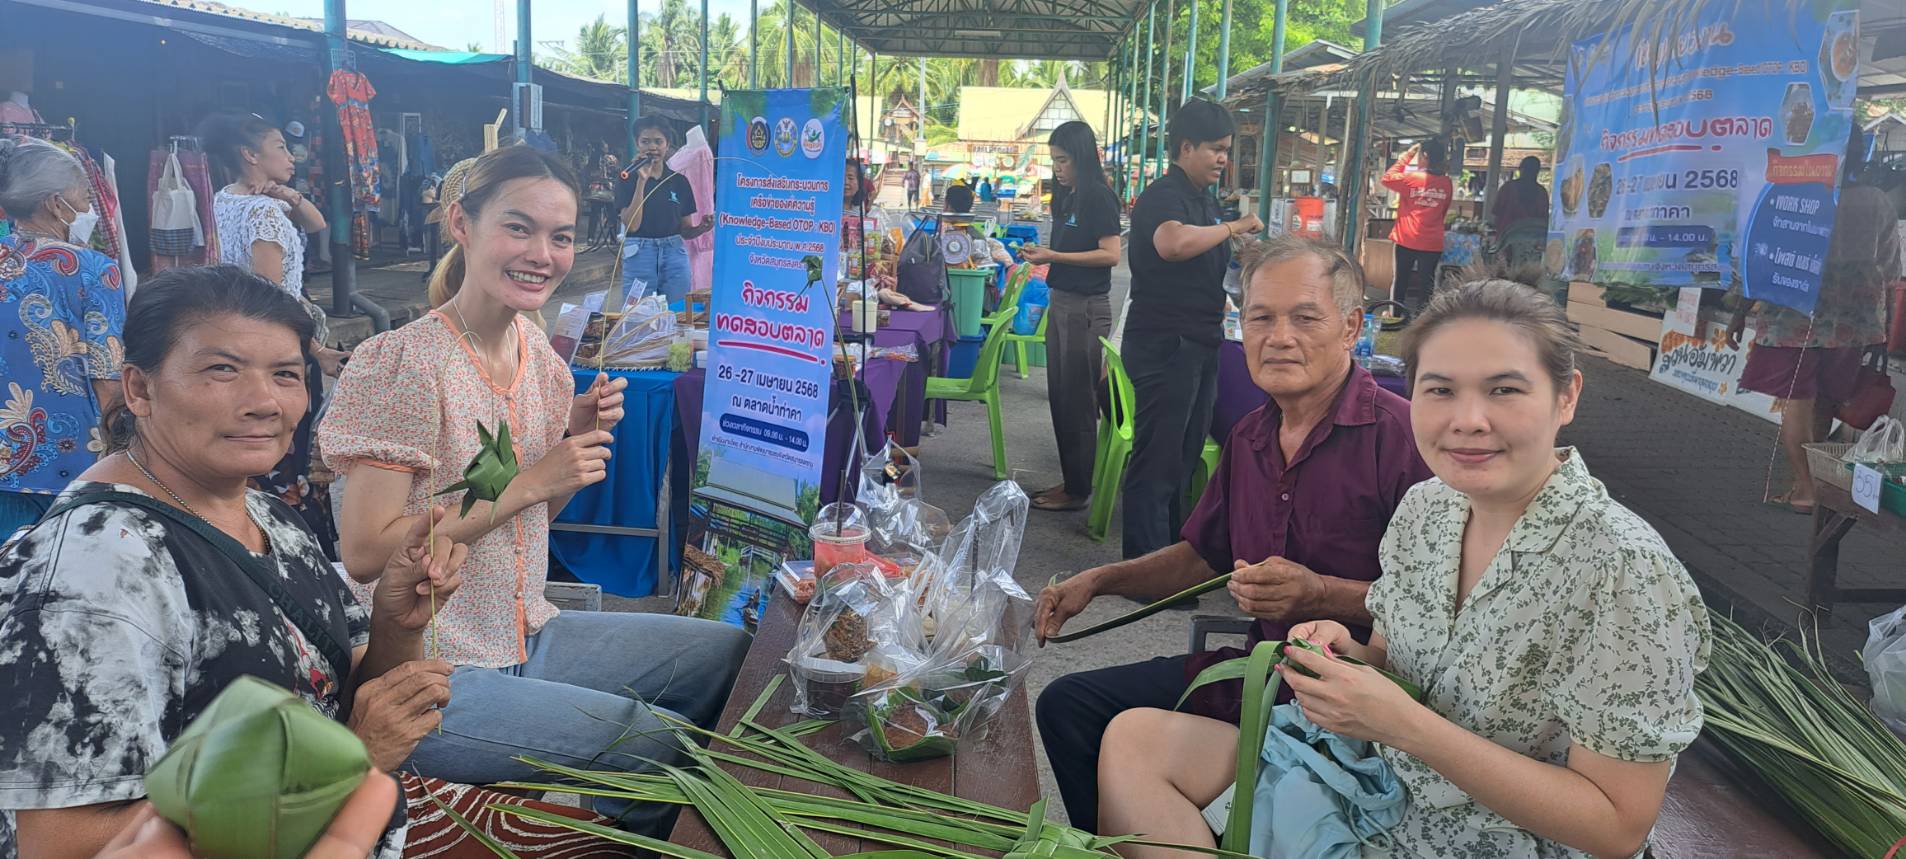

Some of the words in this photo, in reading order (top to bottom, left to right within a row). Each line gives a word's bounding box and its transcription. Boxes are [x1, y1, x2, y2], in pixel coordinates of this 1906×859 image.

[1684, 169, 1739, 190] 2568
[793, 219, 814, 232] OTOP
[1668, 233, 1696, 242] 14.00
[742, 280, 810, 313] กิจกรรม
[716, 312, 825, 350] ทดสอบตลาด
[718, 364, 733, 380] 26
[756, 373, 793, 392] เมษายน
[795, 379, 819, 399] 2568
[743, 394, 802, 422] ตลาดน้ำท่าคา
